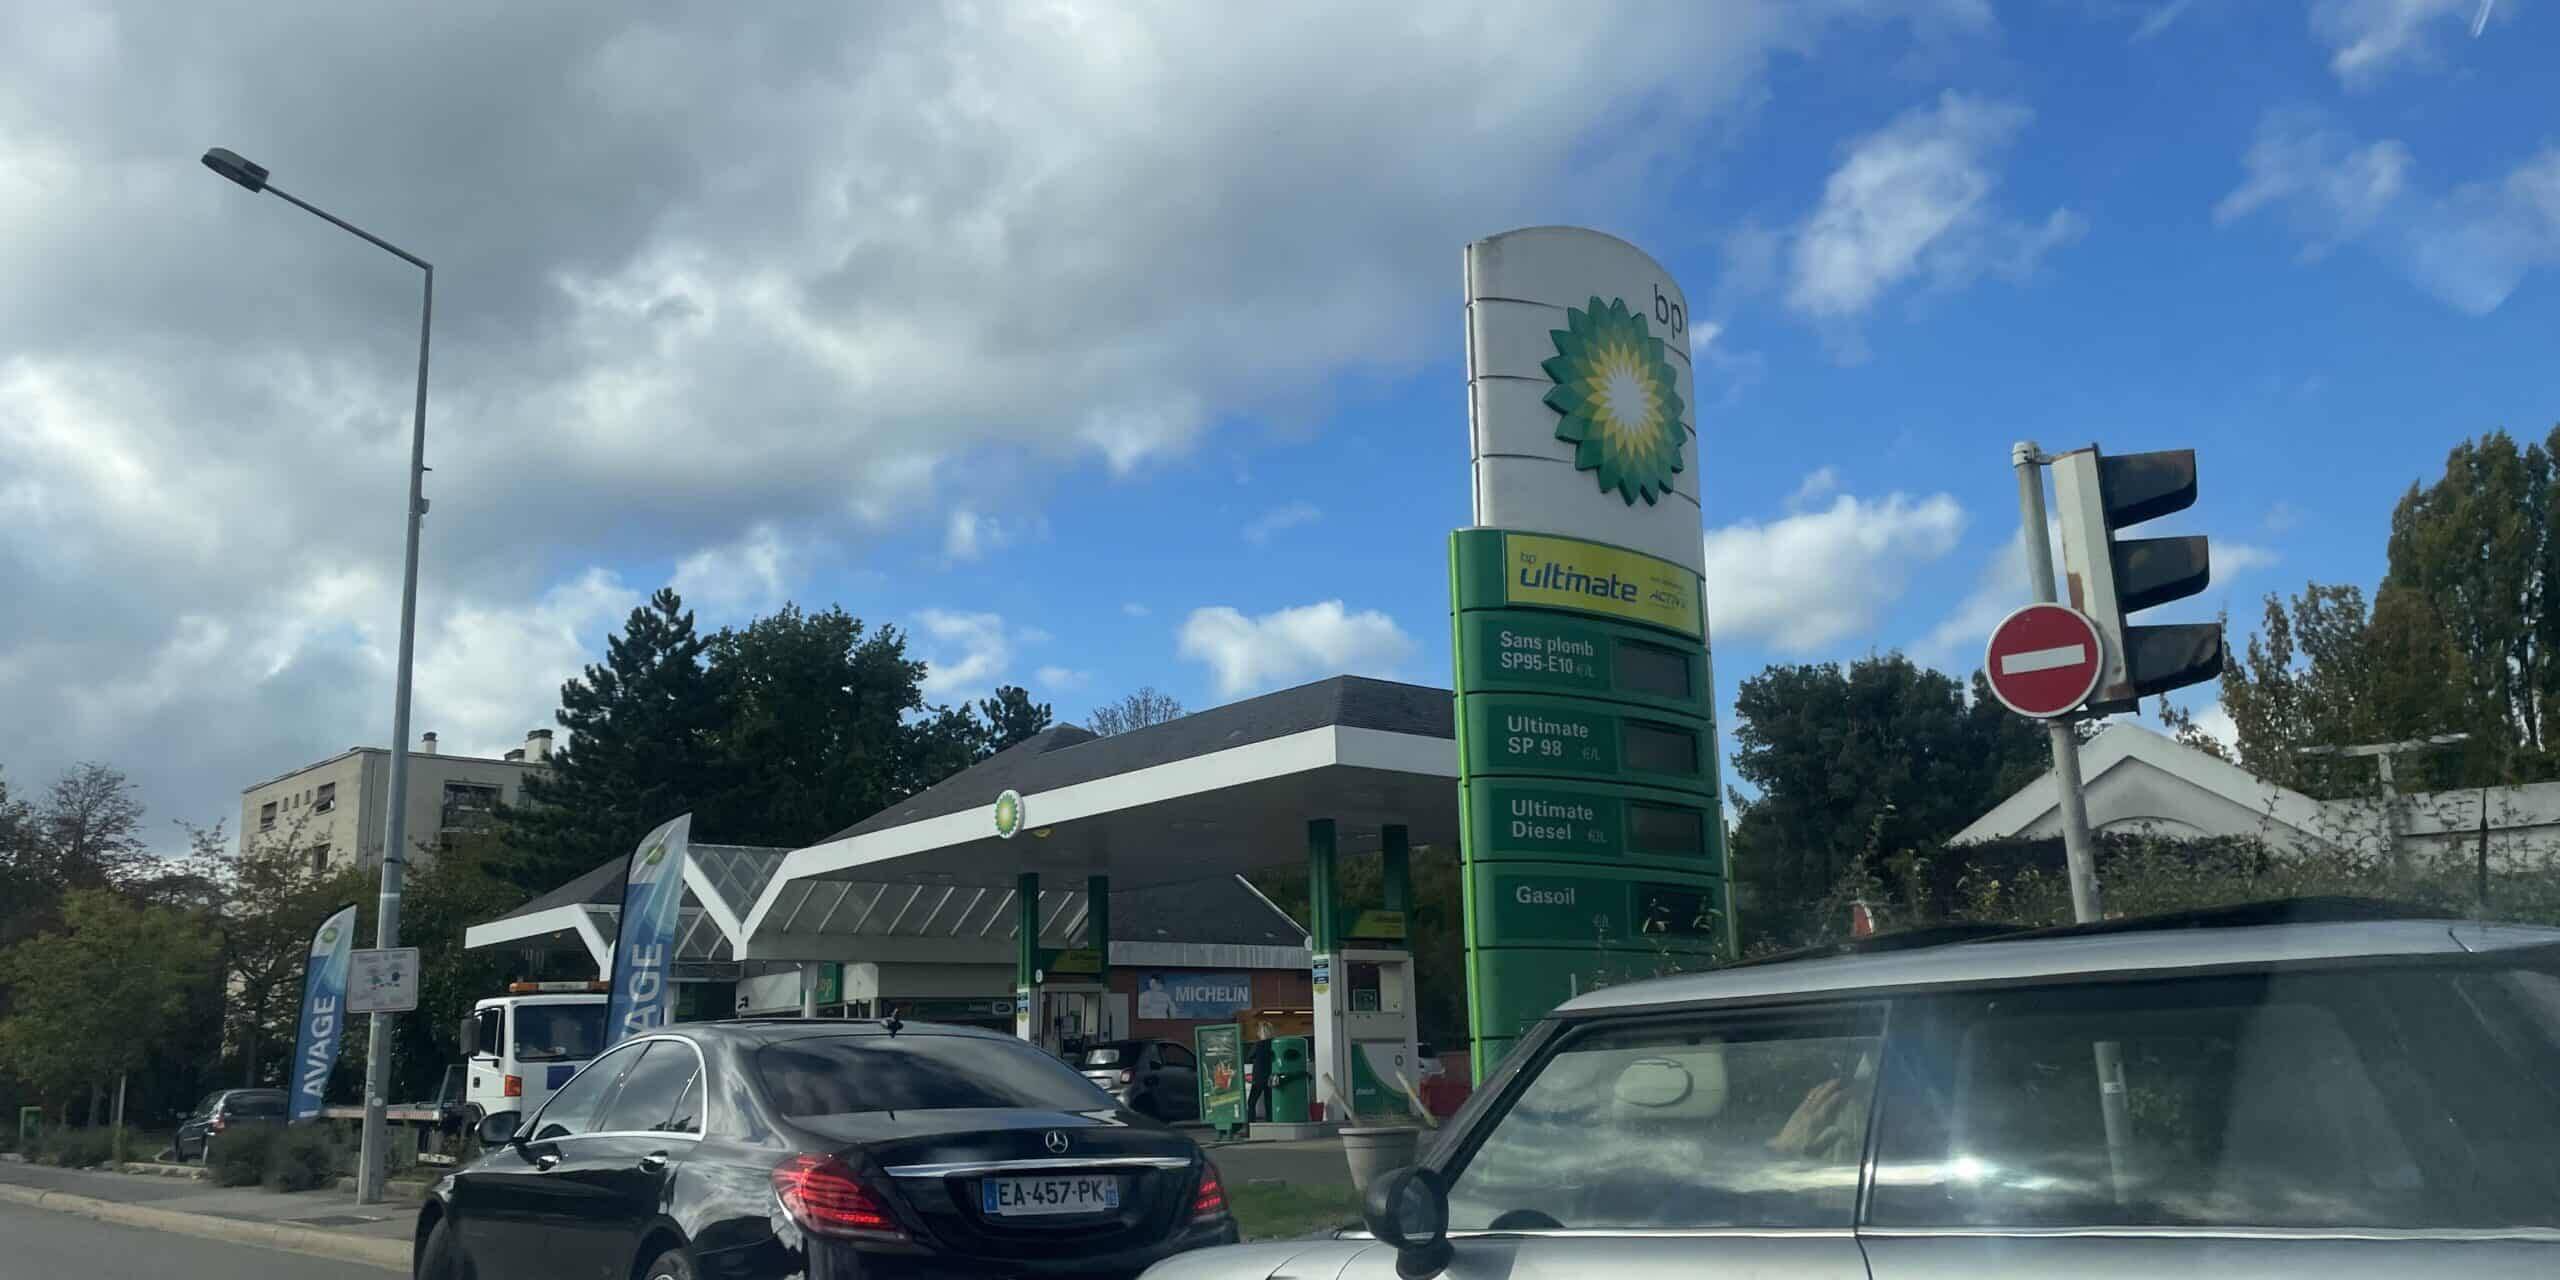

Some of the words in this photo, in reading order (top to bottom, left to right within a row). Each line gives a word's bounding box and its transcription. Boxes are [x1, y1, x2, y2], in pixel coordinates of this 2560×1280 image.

[1654, 283, 1682, 340] bp
[1520, 552, 1536, 563] bp
[1520, 562, 1637, 604] ultimate
[1501, 630, 1542, 650] Sans
[1547, 636, 1594, 656] plomb
[1501, 651, 1573, 674] SP95-E10
[1507, 715, 1588, 738] Ultimate
[1507, 736, 1534, 754] SP
[1541, 739, 1562, 757] 98
[1511, 799, 1593, 820] Ultimate
[1511, 820, 1571, 840] Diesel
[1515, 885, 1575, 904] Gasoil
[1175, 985, 1249, 1003] MICHELIN
[999, 1180, 1104, 1206] EA-457-PK
